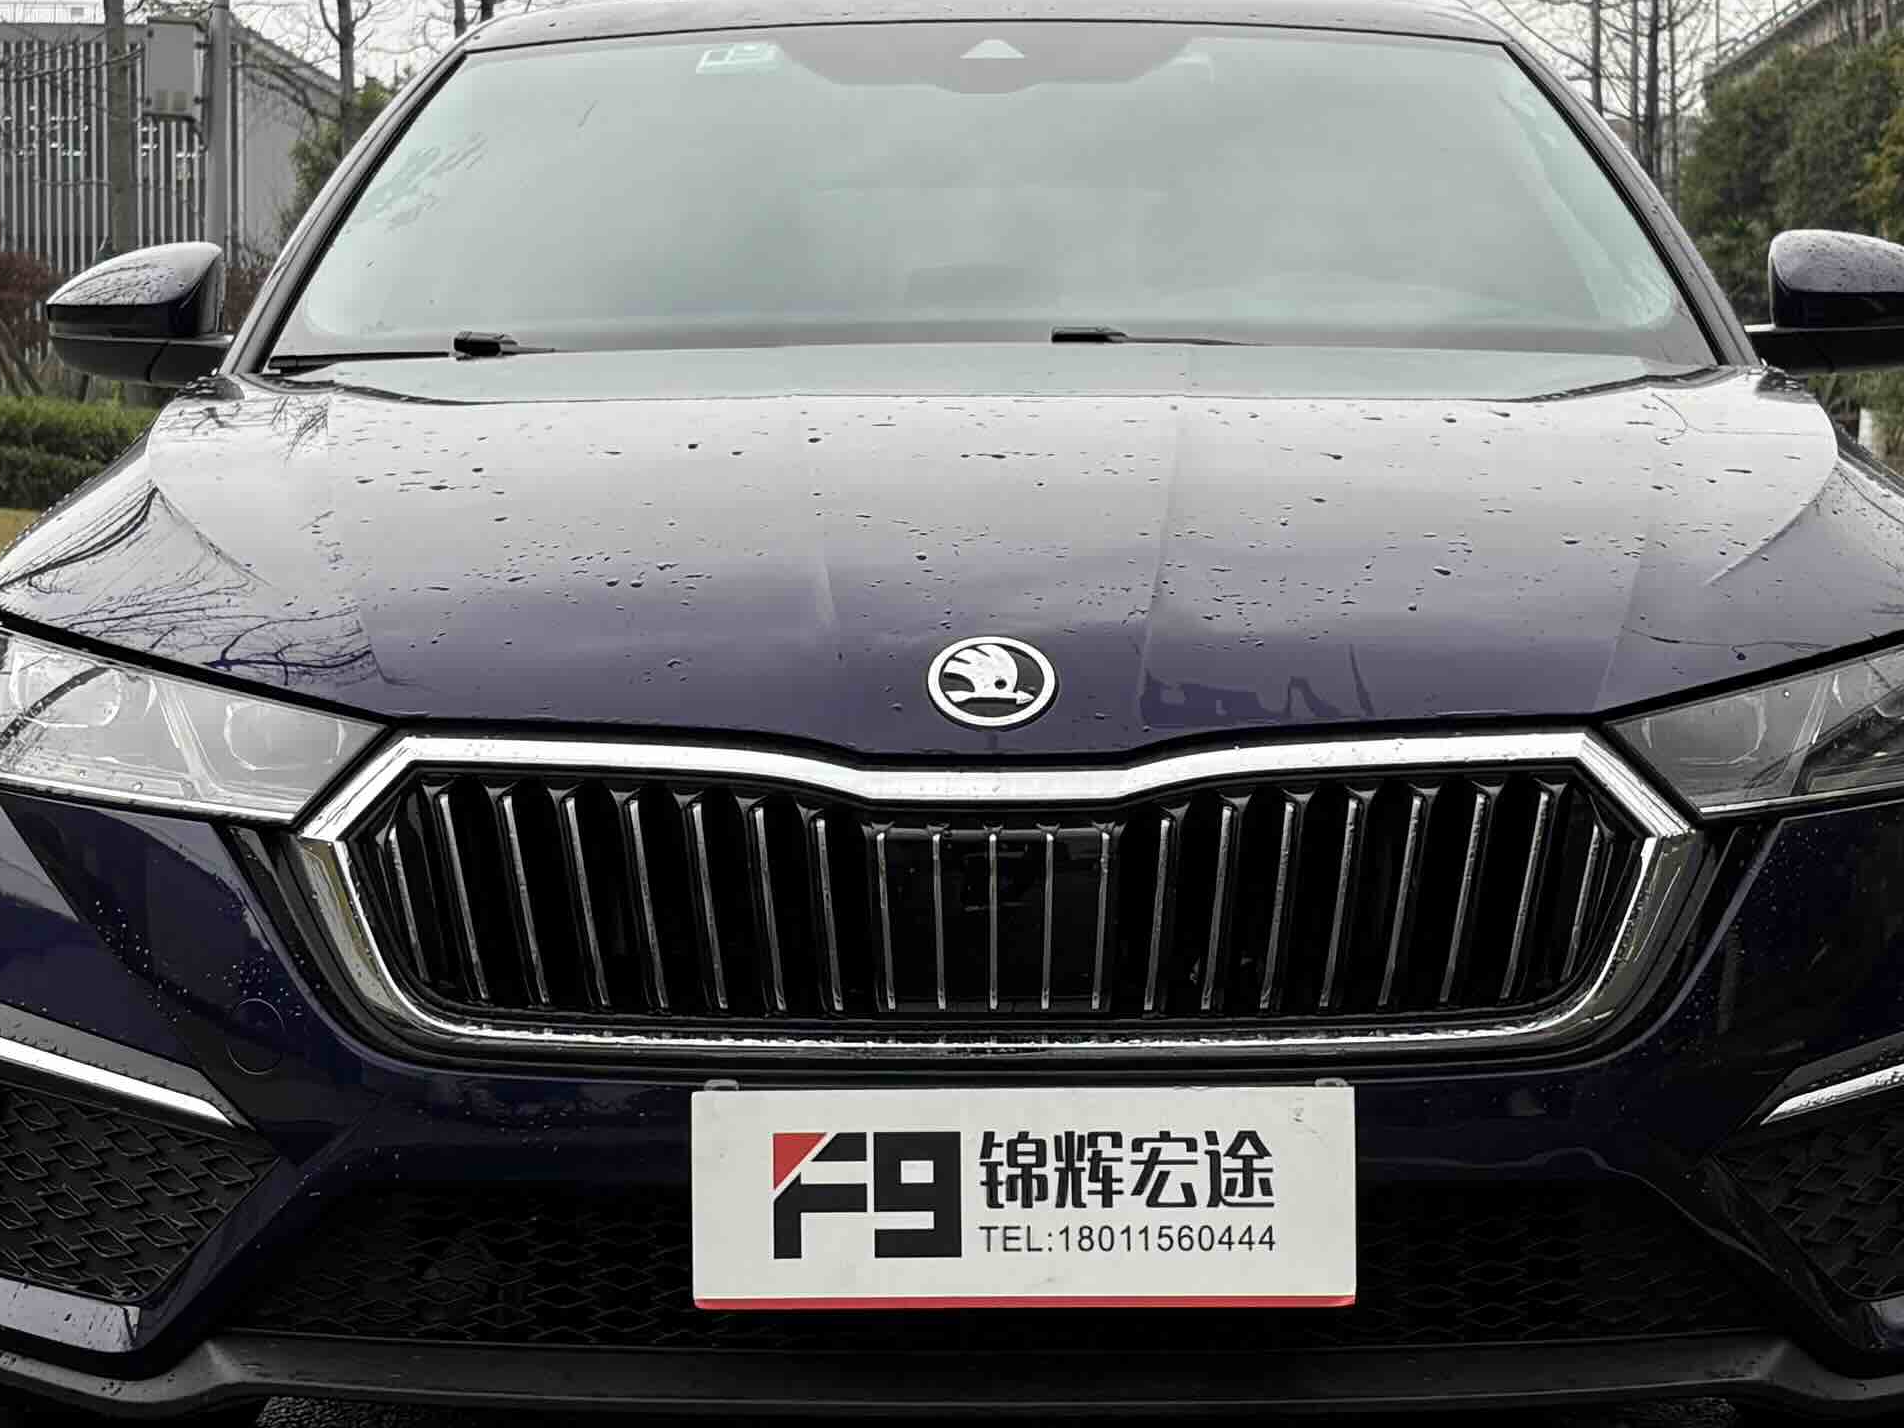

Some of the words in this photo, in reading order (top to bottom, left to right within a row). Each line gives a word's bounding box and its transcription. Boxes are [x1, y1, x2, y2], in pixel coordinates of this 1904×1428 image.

[772, 1131, 963, 1259] F9
[979, 1130, 1274, 1208] 锦辉宏途
[978, 1224, 1275, 1253] TEL:18011560444
